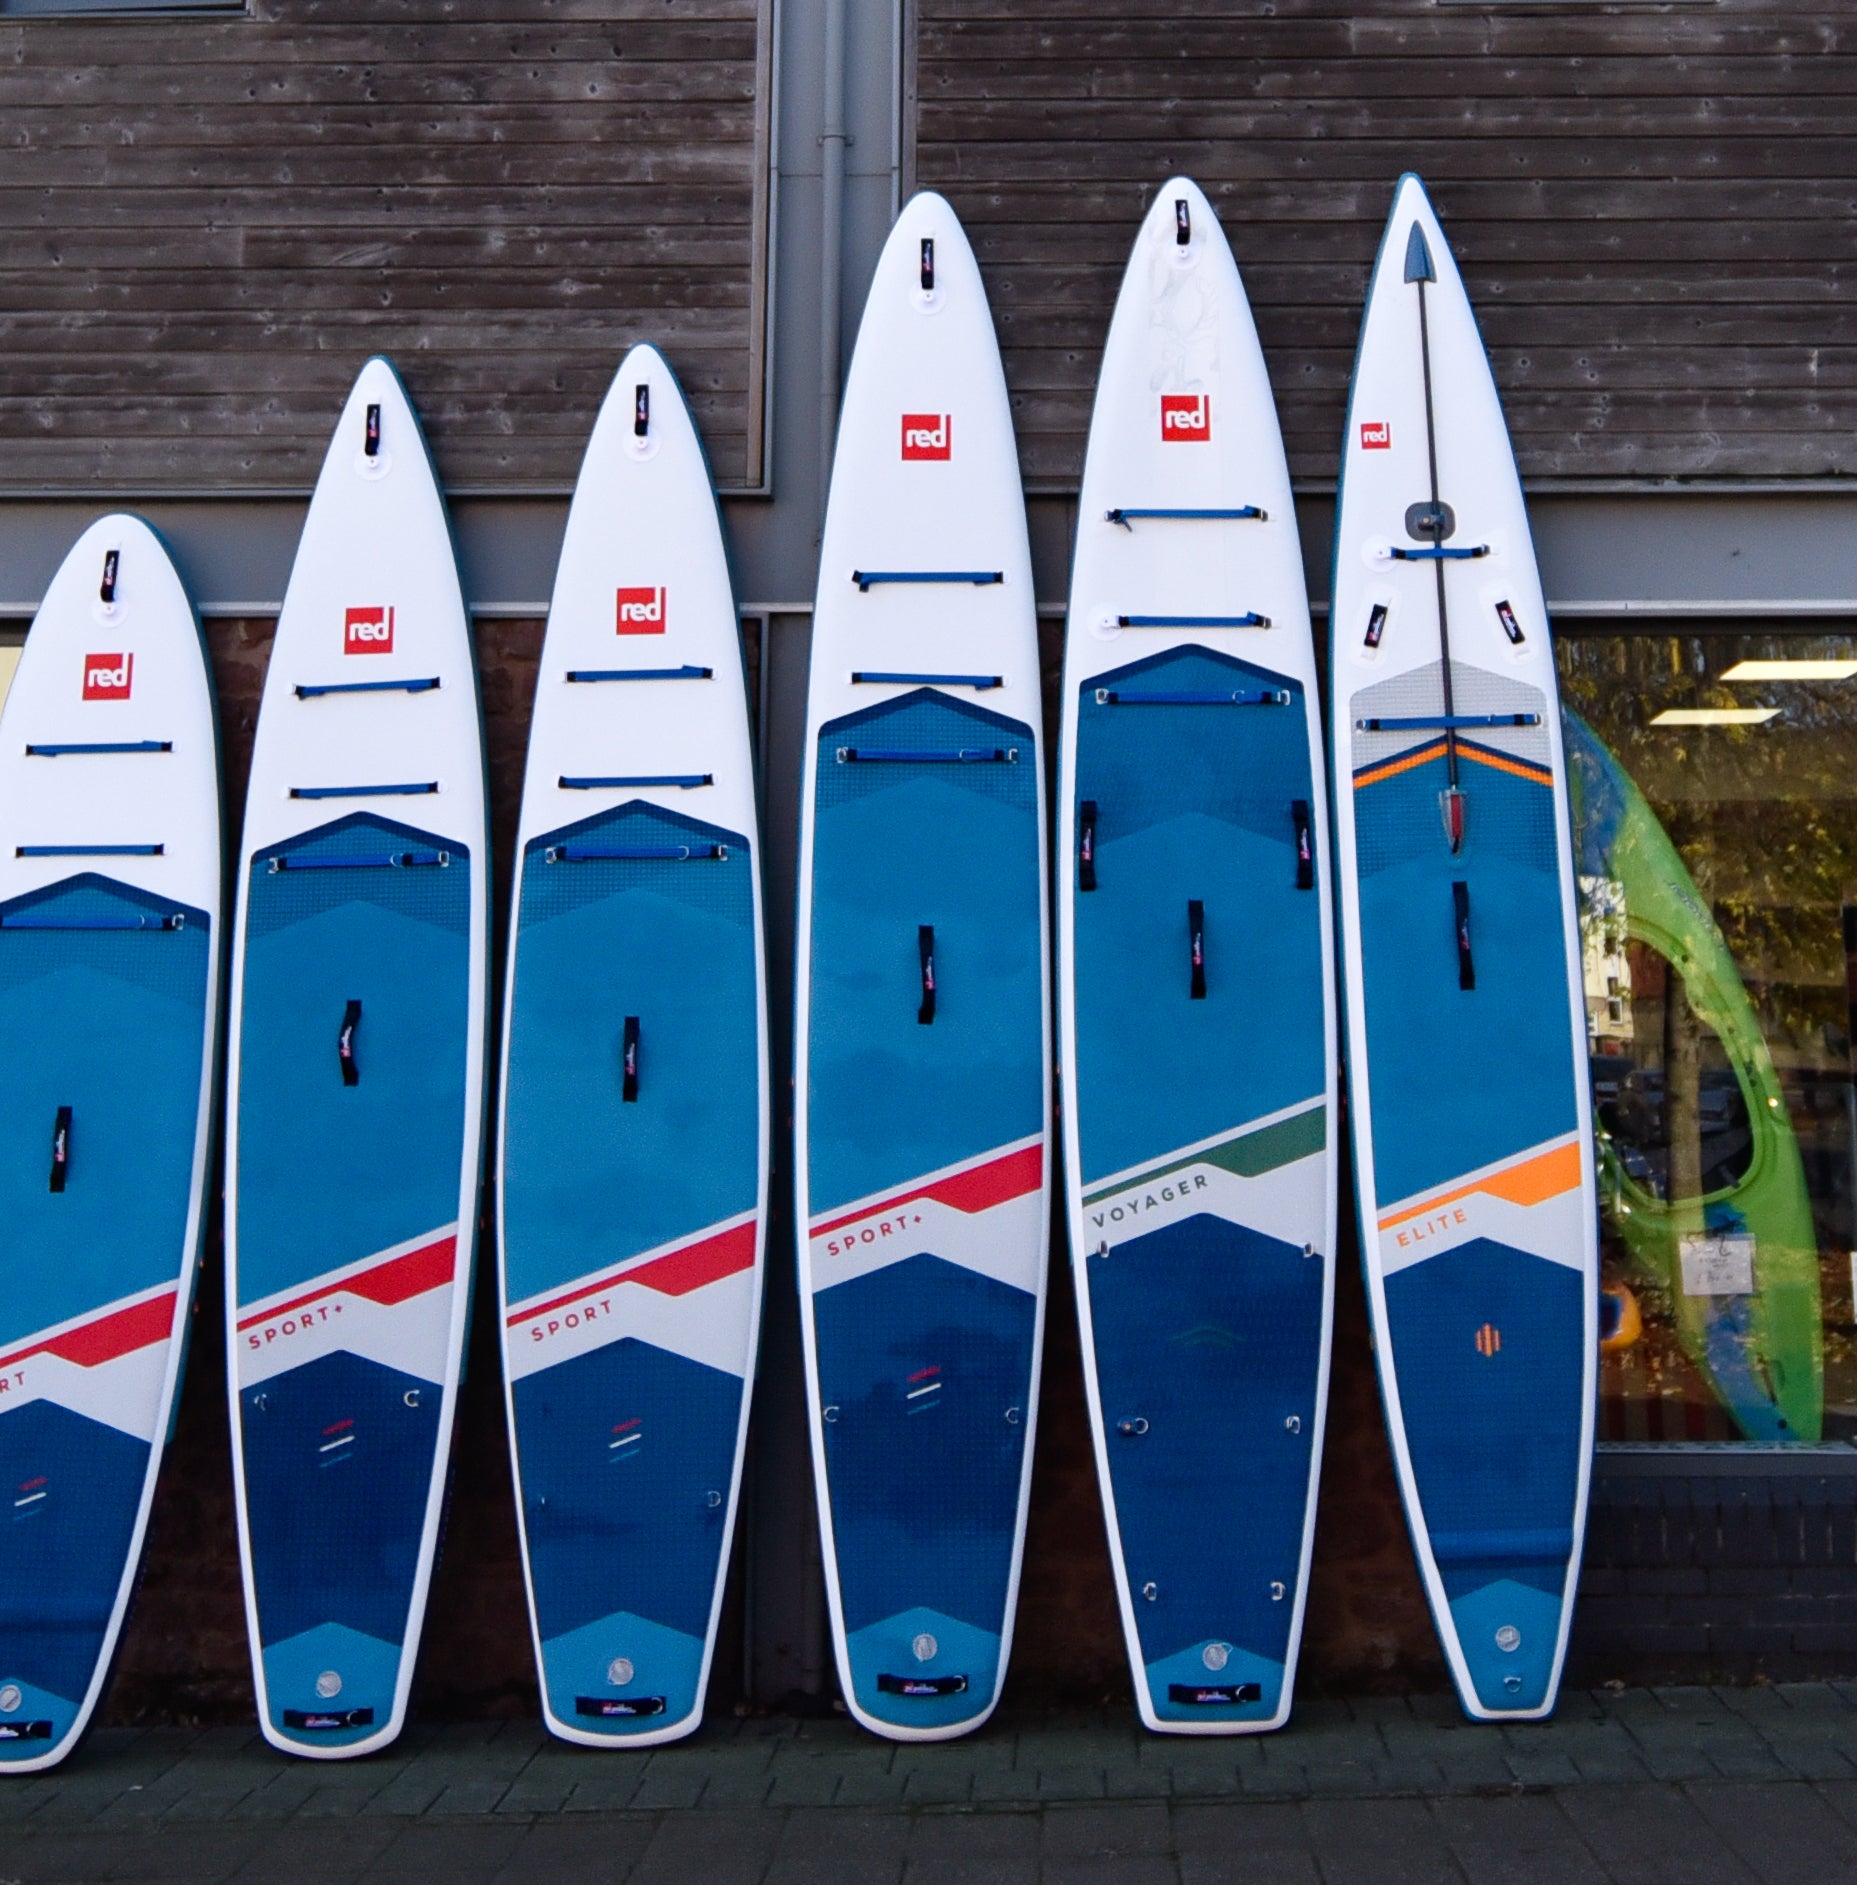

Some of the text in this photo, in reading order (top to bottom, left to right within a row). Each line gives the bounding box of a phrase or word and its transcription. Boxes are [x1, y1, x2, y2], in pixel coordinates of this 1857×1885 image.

[1166, 395, 1205, 429] red
[906, 414, 946, 448] red
[1363, 422, 1387, 442] red
[621, 587, 661, 622] red
[349, 606, 390, 641] red
[88, 652, 128, 687] red
[1092, 1175, 1208, 1228] VOYAGER
[1396, 1208, 1467, 1247] ELITE
[531, 1299, 611, 1342] SPORT
